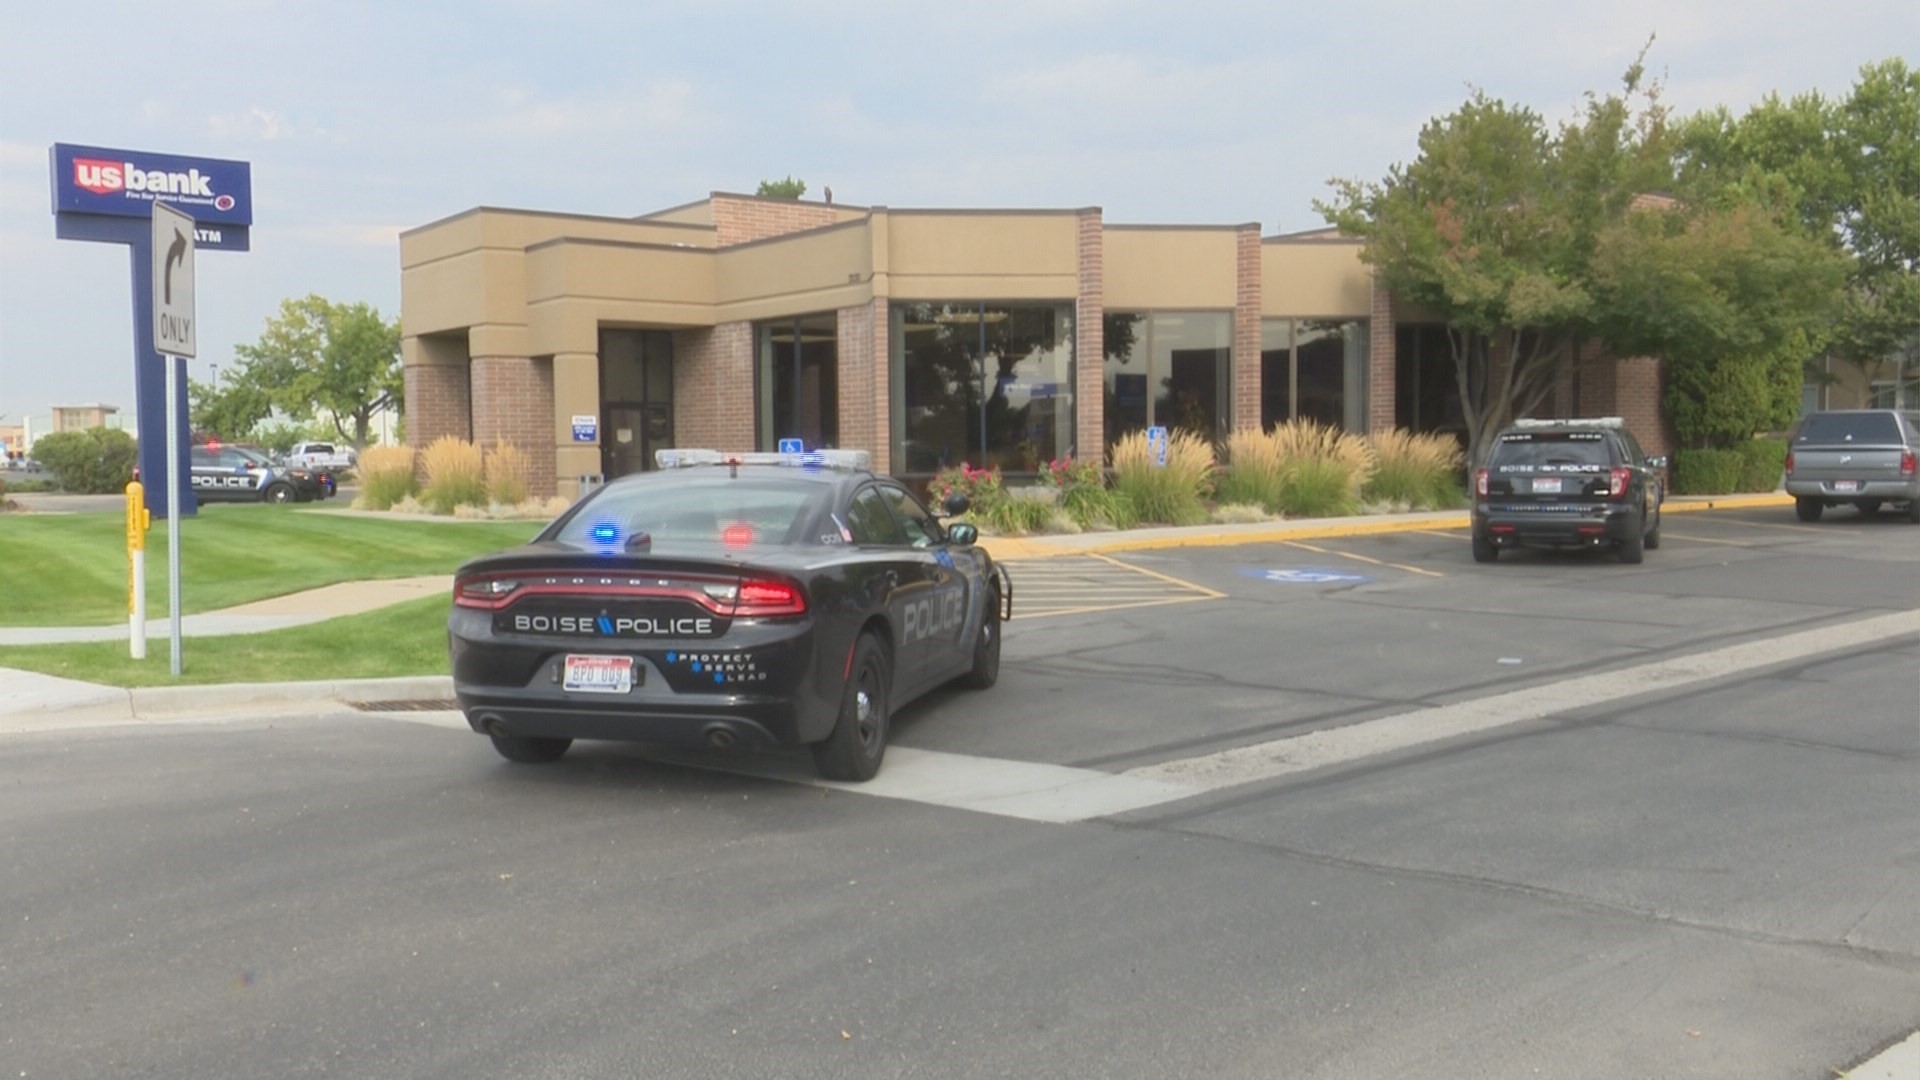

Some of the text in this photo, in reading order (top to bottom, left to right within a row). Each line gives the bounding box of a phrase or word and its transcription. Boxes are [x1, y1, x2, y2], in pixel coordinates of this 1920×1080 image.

[193, 228, 221, 243] ATM
[160, 312, 190, 345] ONLY
[1500, 464, 1600, 473] BOISE POLICE
[191, 475, 250, 488] POLICE
[903, 587, 964, 645] POLICE
[514, 615, 713, 635] BOISE POLICE
[679, 654, 752, 662] PROTECT
[704, 663, 756, 672] SERVE
[727, 671, 767, 681] LEAD
